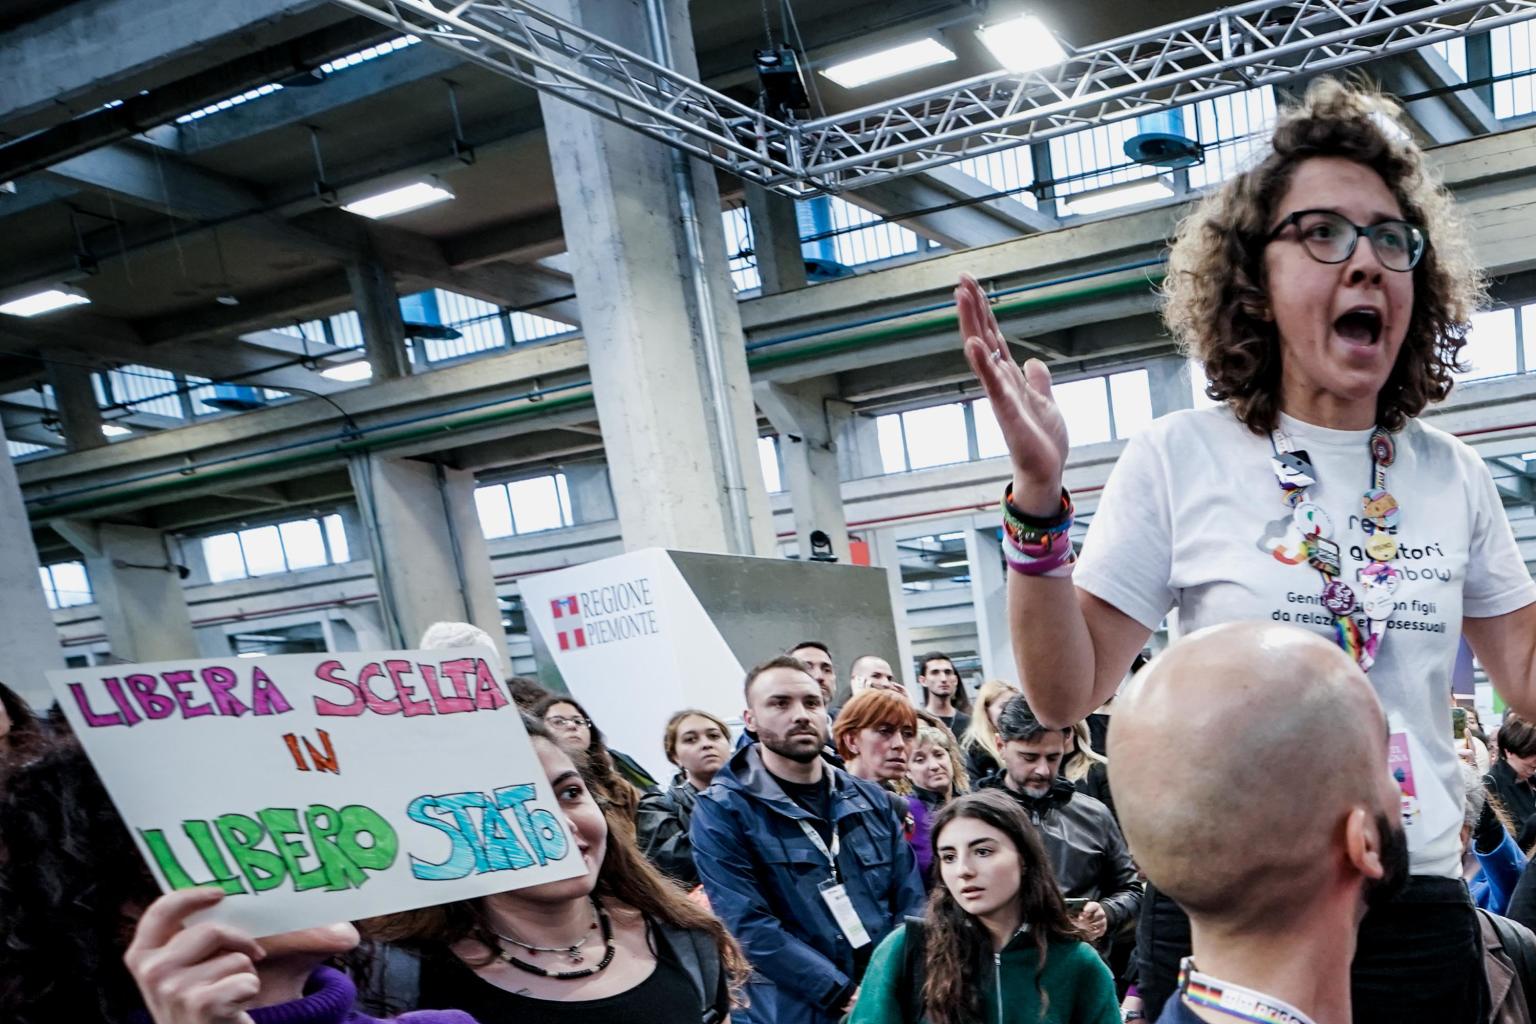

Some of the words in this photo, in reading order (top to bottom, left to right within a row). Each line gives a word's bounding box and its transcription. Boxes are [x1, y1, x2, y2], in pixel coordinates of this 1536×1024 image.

[580, 578, 653, 618] REGIONE
[1272, 609, 1290, 622] da
[1412, 600, 1437, 615] figli
[586, 610, 660, 646] PIEMONTE
[68, 666, 292, 727] LIBERA
[313, 656, 508, 717] SCELTA
[283, 728, 340, 775] IN
[137, 803, 399, 896] LIBERO
[408, 783, 568, 881] STATO
